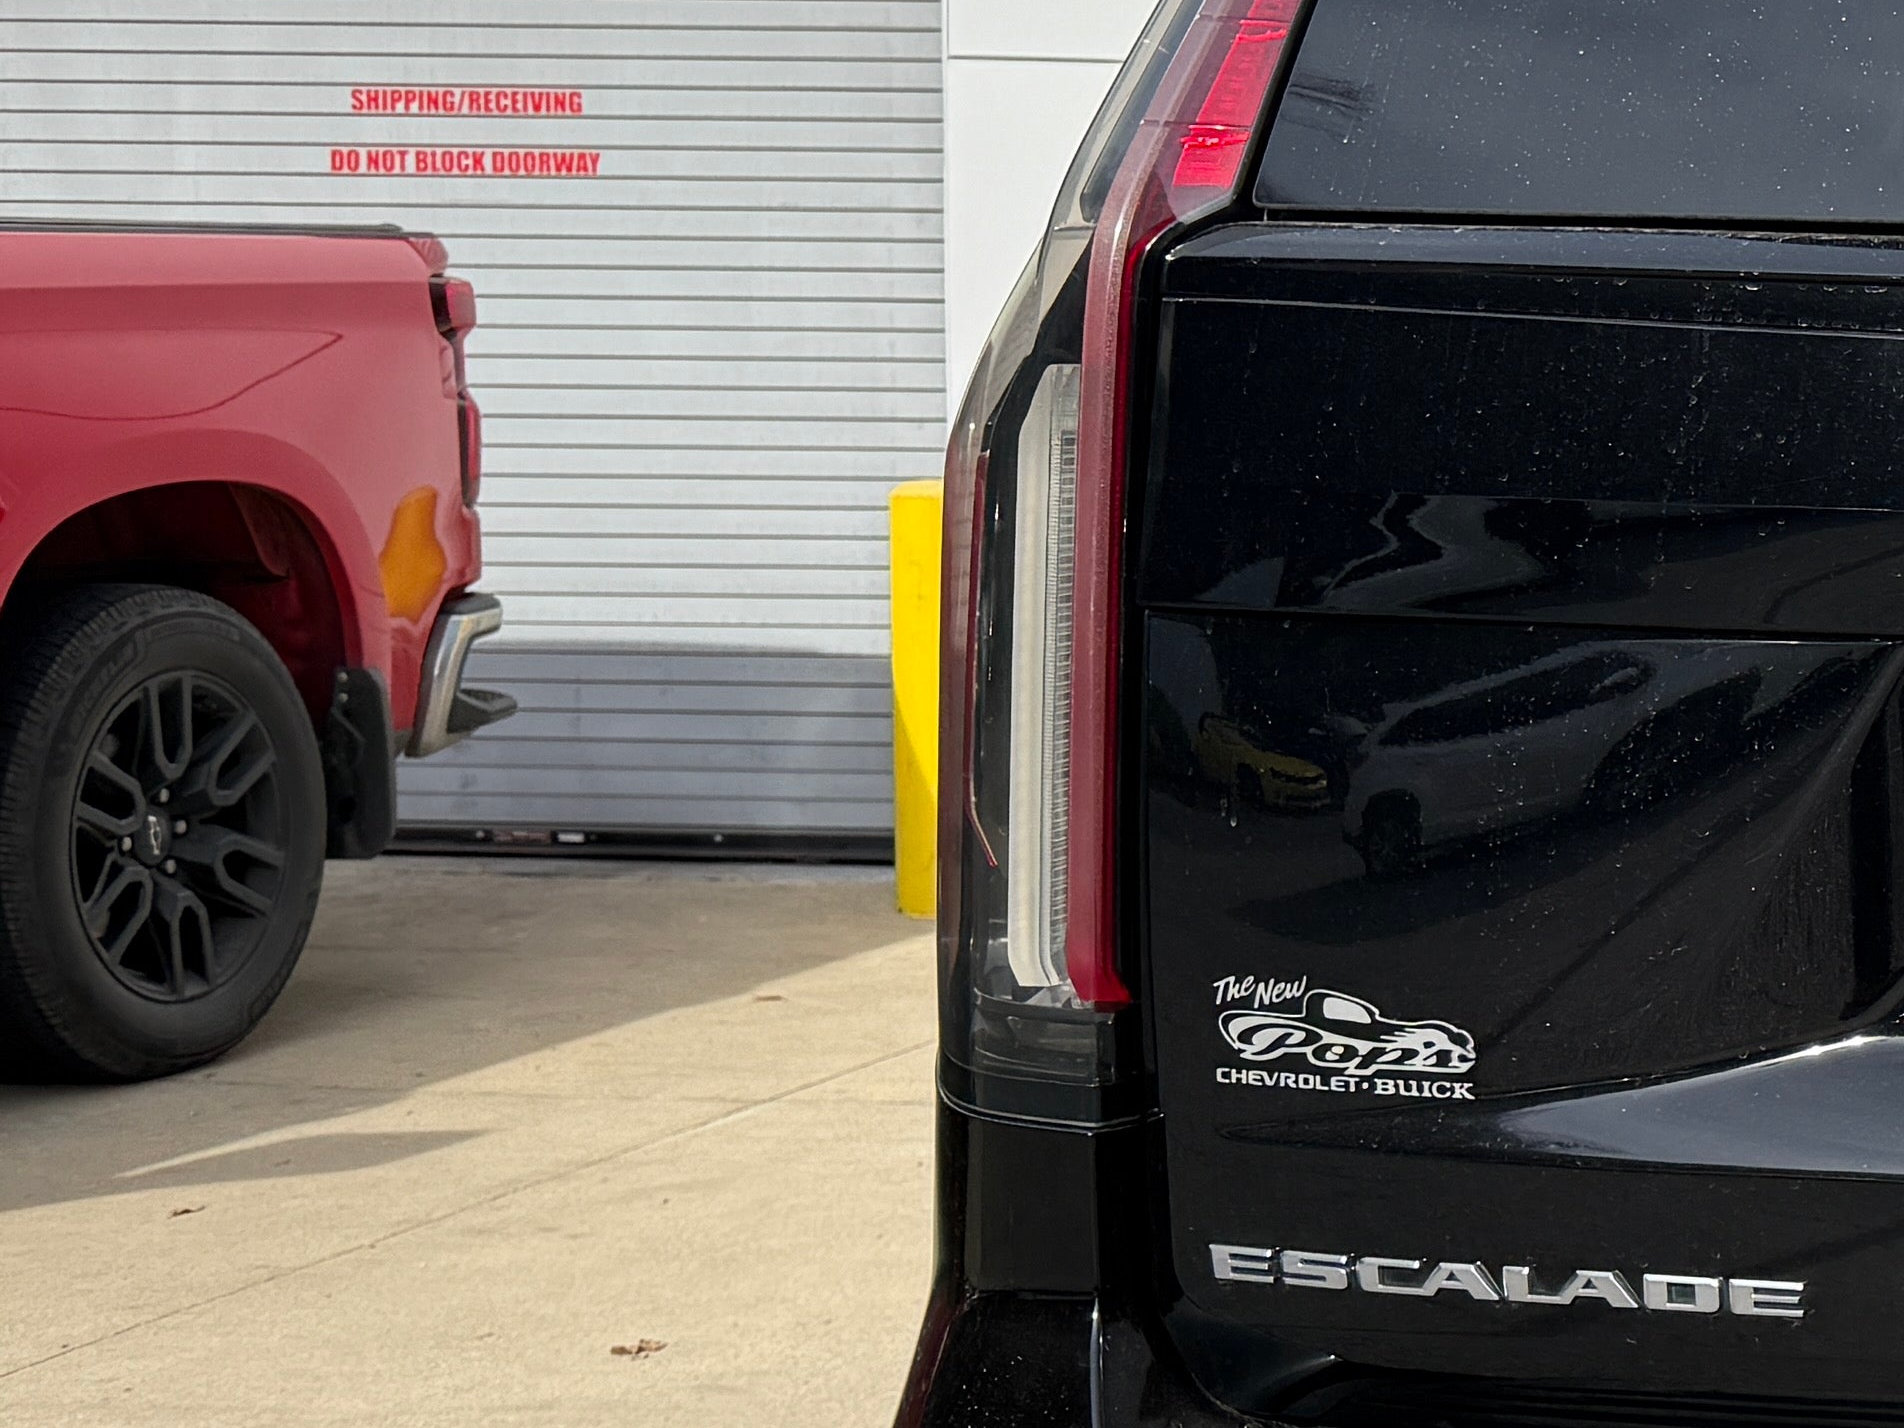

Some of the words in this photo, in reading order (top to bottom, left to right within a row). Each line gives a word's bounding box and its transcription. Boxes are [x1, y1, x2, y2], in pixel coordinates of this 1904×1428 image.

[351, 89, 583, 114] SHIPPING/RECEIVING
[330, 149, 360, 172] DO
[366, 149, 409, 173] NOT
[415, 150, 485, 174] BLOCK
[491, 151, 601, 176] DOORWAY
[1213, 975, 1255, 1005] The
[1253, 975, 1307, 1009] New
[1208, 1243, 1807, 1318] ESCALADE
